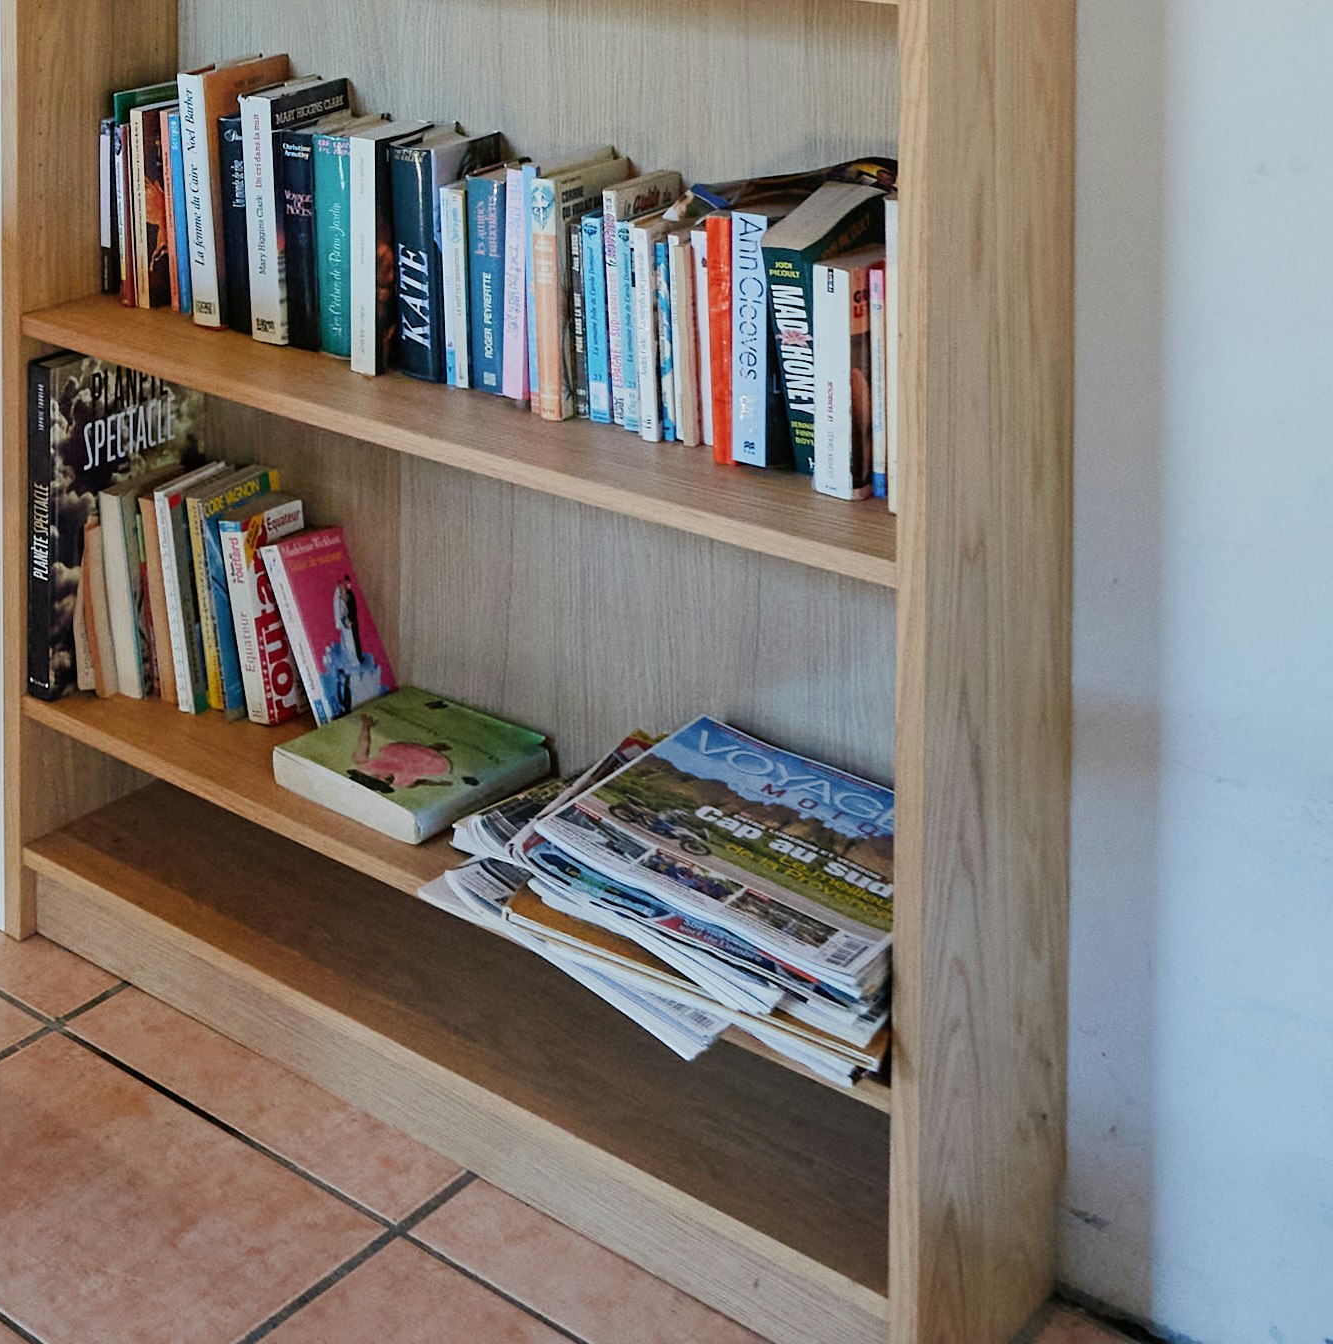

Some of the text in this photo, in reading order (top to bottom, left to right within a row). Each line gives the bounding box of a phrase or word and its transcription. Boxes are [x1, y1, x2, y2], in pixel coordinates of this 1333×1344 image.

[254, 132, 261, 140] la
[283, 143, 311, 152] Christine
[255, 177, 263, 188] Un
[255, 195, 264, 218] Clark
[257, 220, 267, 252] Higgins
[257, 253, 268, 274] Mary
[397, 243, 432, 349] KATE
[738, 217, 764, 380] Ann Cleeves
[484, 328, 494, 359] ROGER
[770, 285, 815, 415] MAD HONEY
[84, 397, 176, 471] SPECTACLE
[226, 478, 260, 507] VAGNON
[31, 481, 49, 580] PLANÈTE SPECTACLE
[229, 537, 245, 584] routard
[695, 805, 894, 898] Cap au sud
